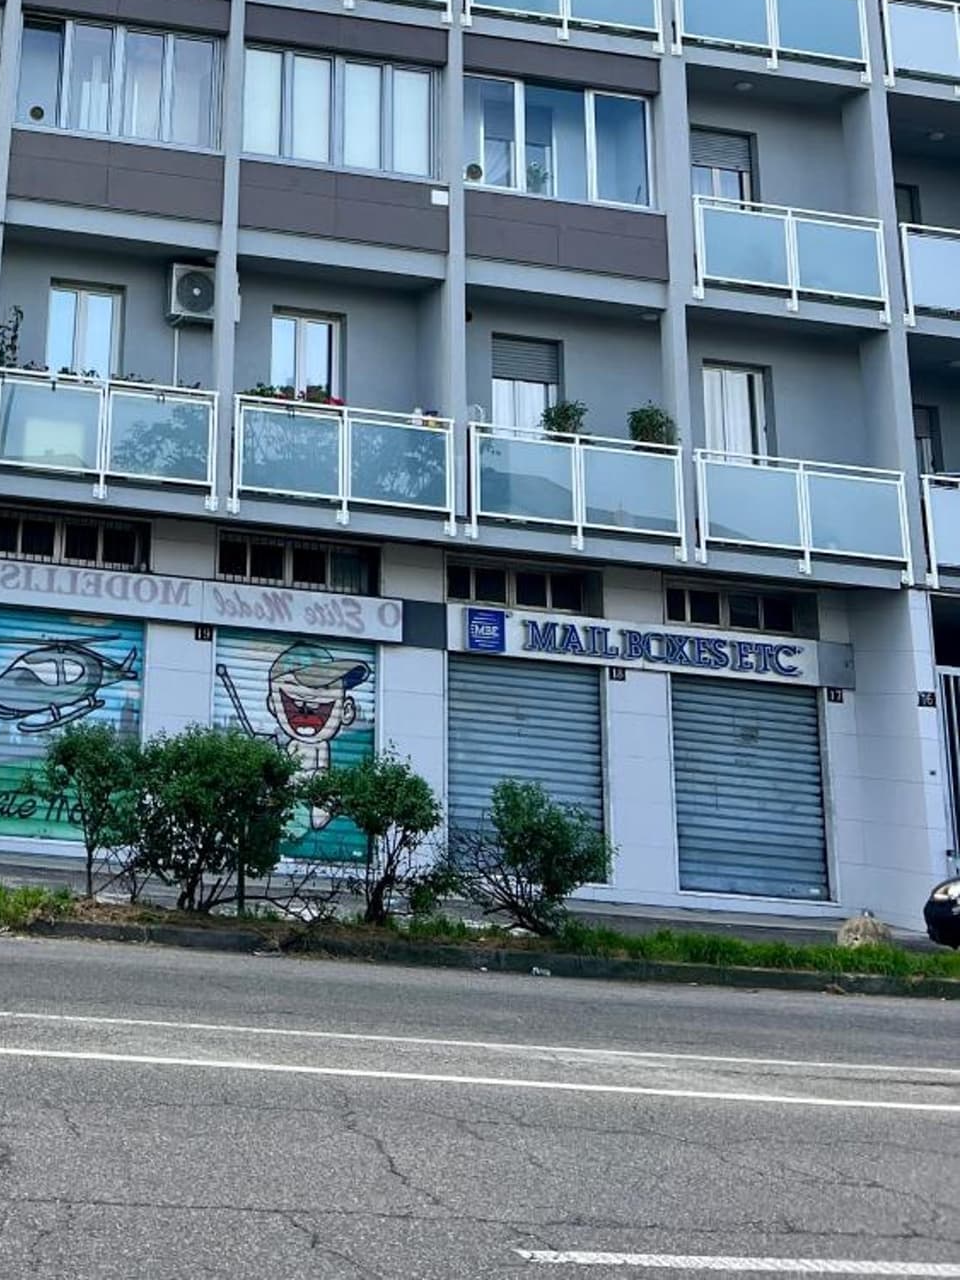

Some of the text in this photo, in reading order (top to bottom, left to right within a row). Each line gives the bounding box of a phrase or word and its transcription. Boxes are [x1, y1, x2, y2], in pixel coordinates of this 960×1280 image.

[198, 627, 211, 640] 19
[523, 620, 619, 659] MAIL
[621, 629, 730, 669] BOXES
[829, 689, 842, 701] 17
